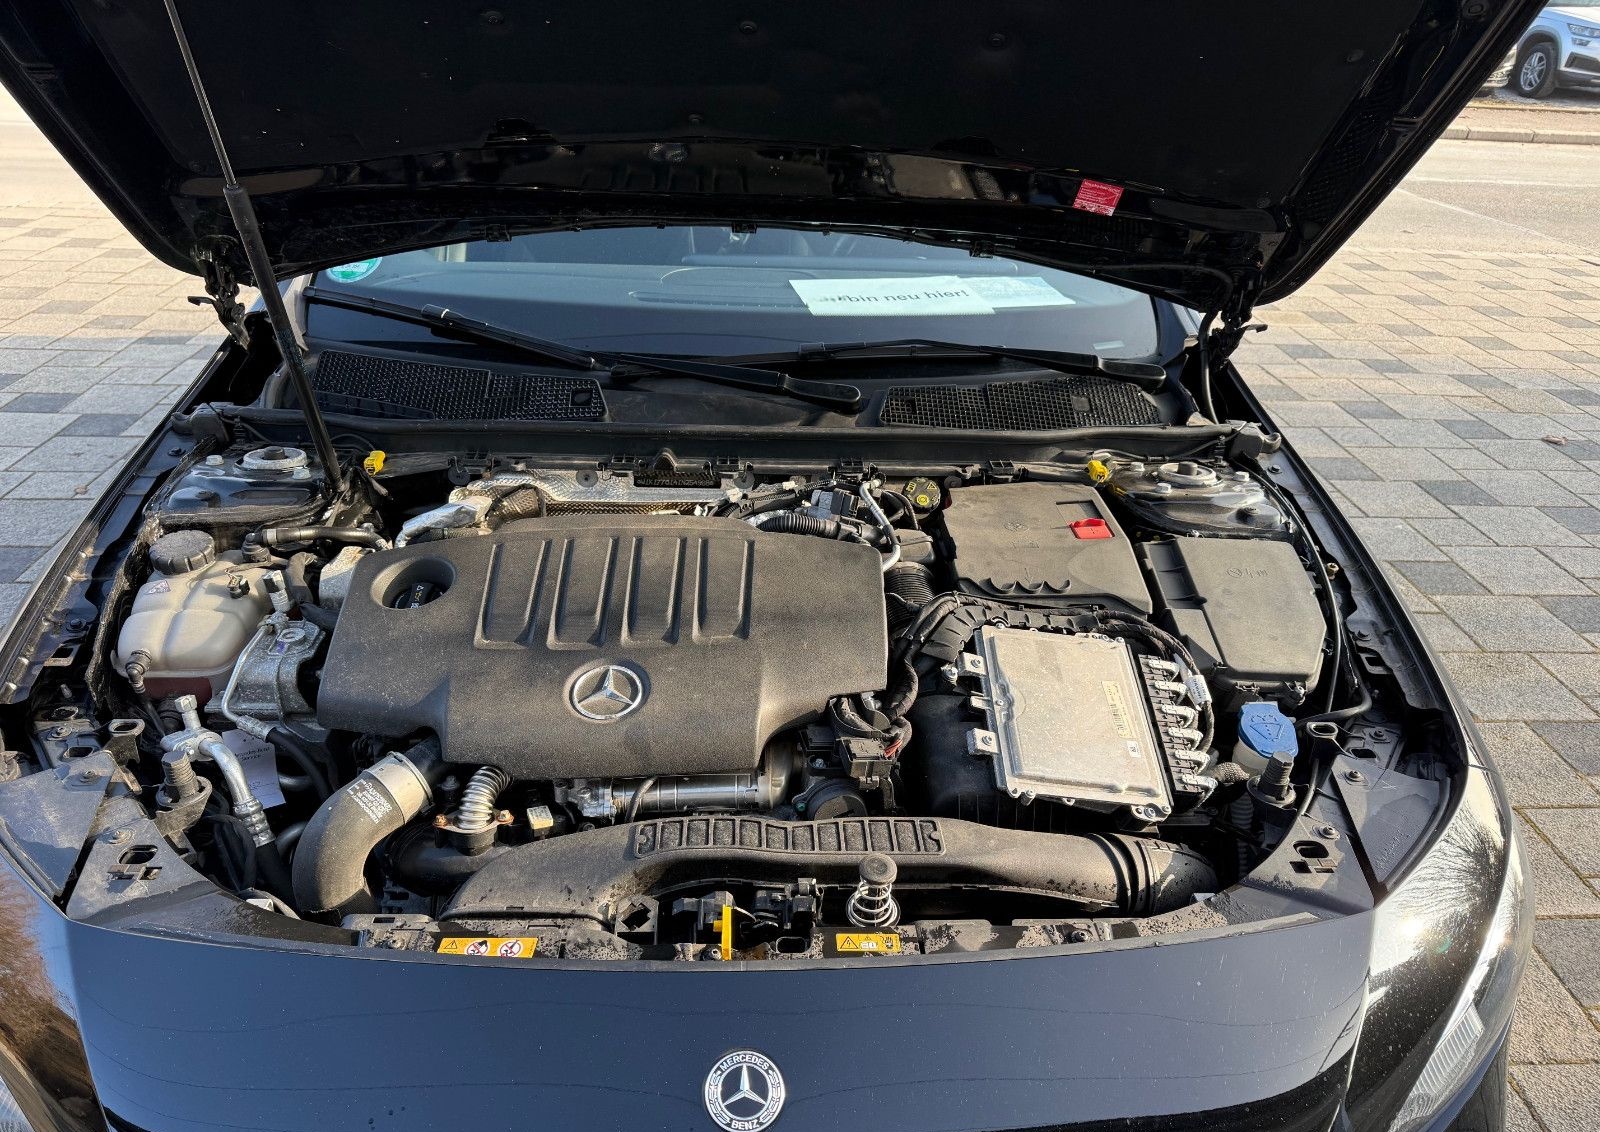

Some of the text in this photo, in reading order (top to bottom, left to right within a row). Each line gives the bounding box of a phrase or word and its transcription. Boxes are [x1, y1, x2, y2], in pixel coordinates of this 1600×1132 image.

[847, 294, 878, 303] bin
[883, 293, 920, 302] neu
[924, 288, 969, 300] hier!
[719, 1054, 770, 1072] MERCEDES
[730, 1119, 760, 1131] BENZ
